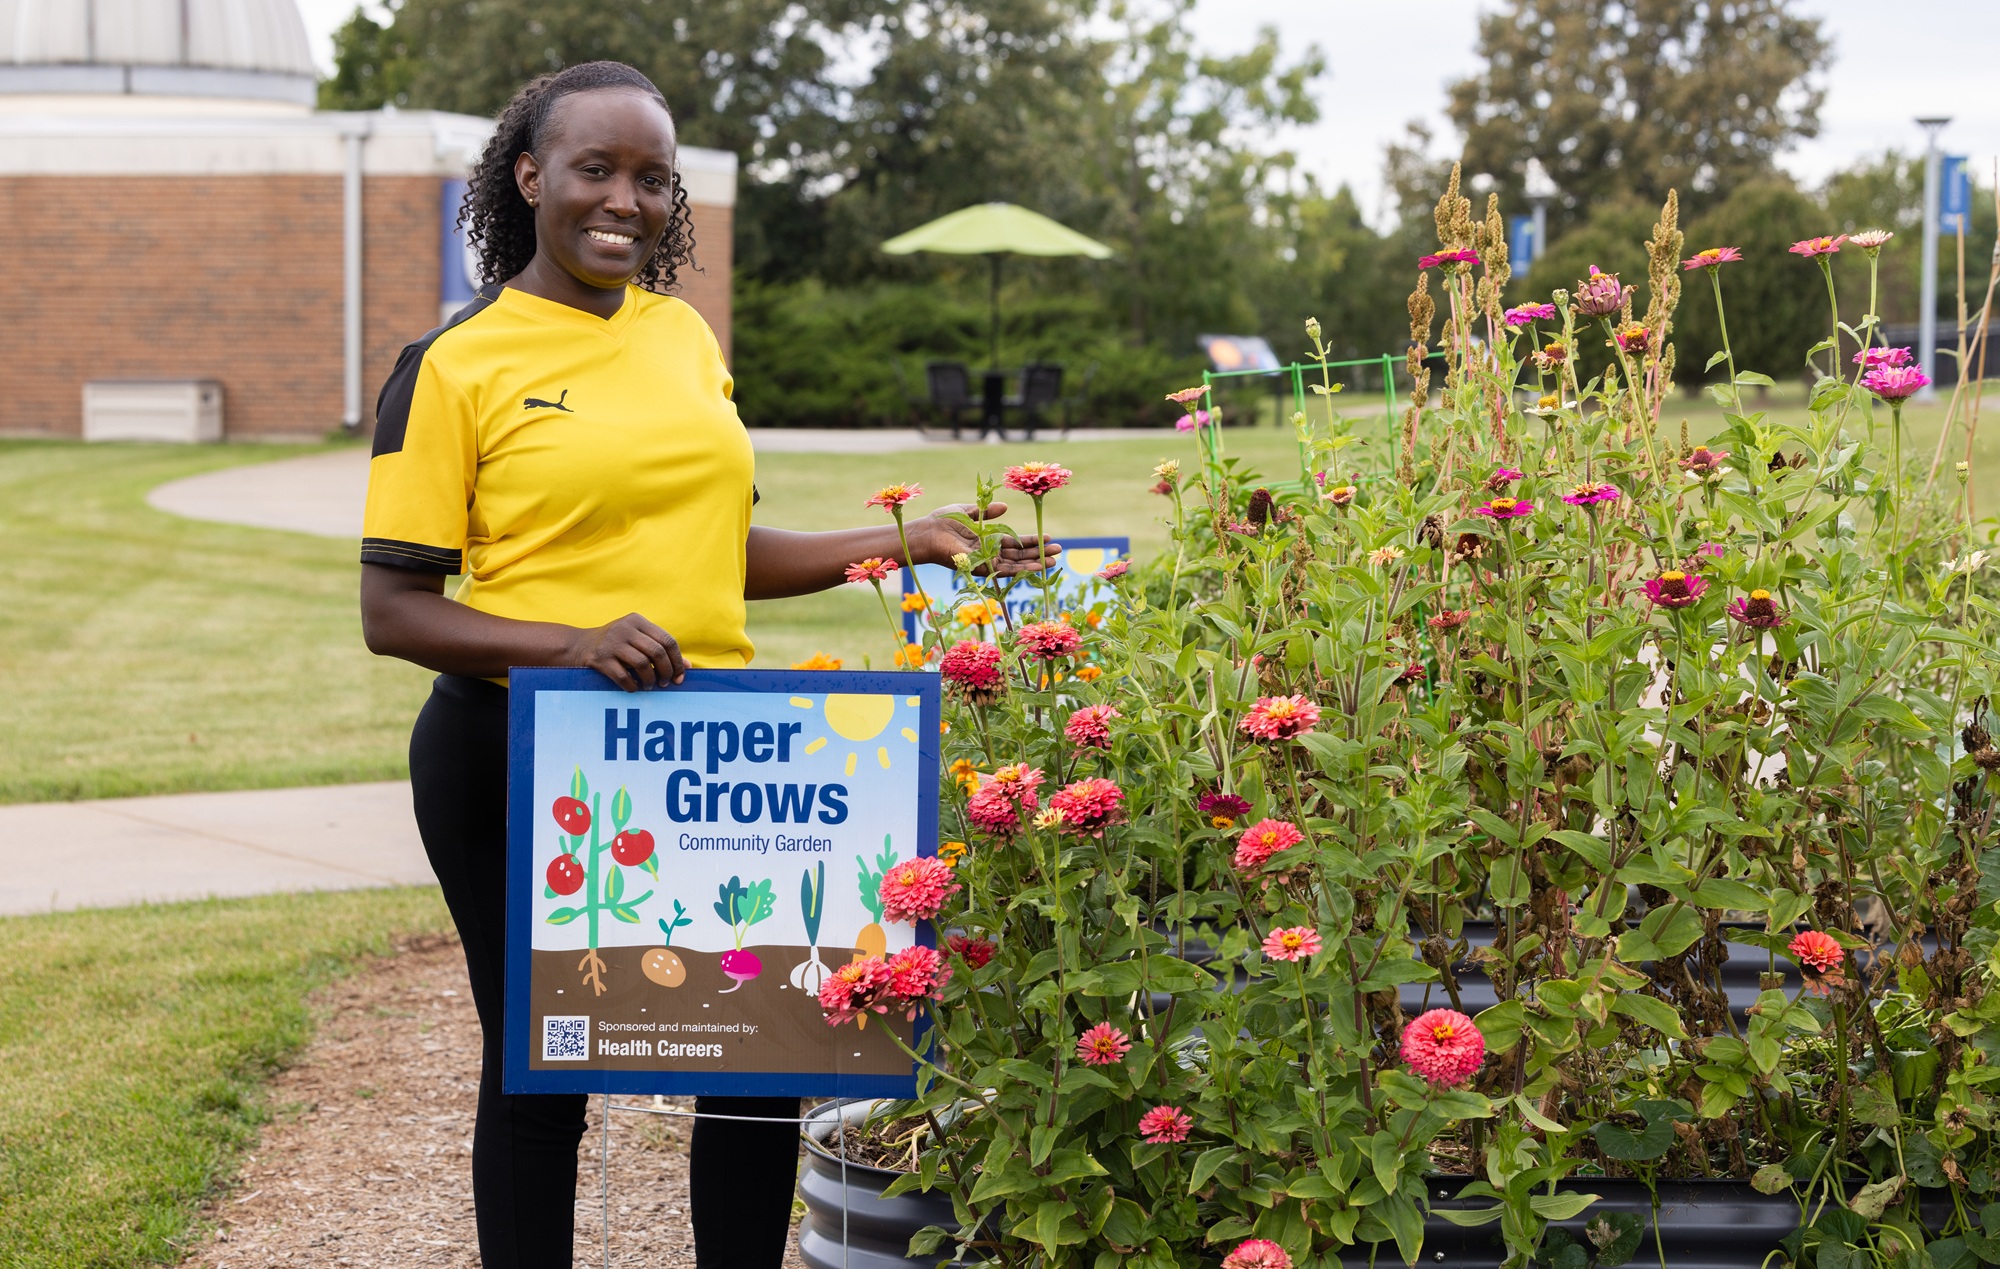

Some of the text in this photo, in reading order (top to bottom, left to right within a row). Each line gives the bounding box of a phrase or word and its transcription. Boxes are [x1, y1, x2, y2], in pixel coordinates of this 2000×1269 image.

[604, 708, 802, 774] Harper
[665, 769, 849, 825] Grows
[679, 833, 832, 855] Community Garden
[598, 1021, 759, 1035] Sponsored and maintained by:
[598, 1039, 723, 1057] Health Careers
